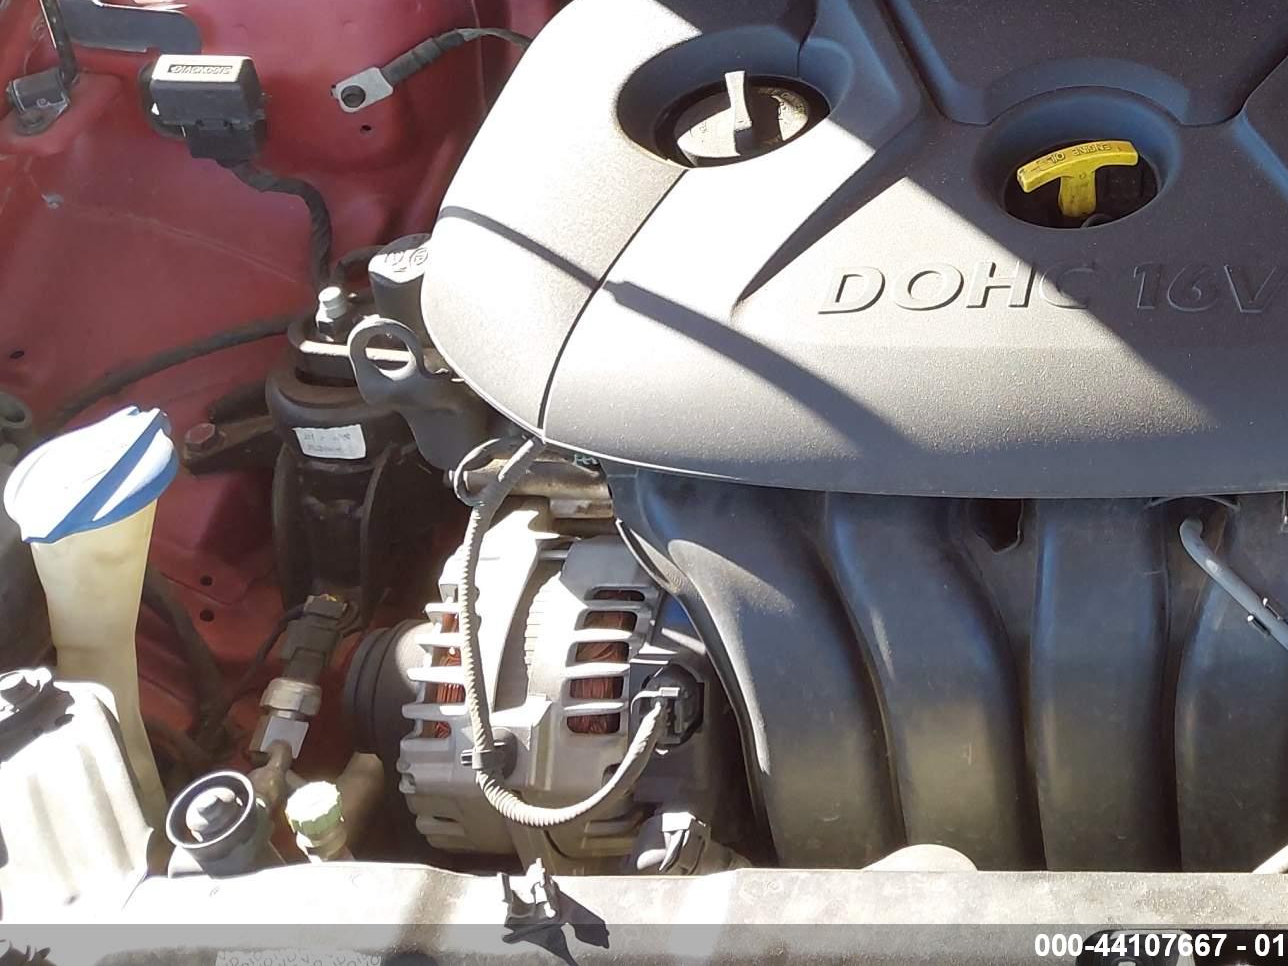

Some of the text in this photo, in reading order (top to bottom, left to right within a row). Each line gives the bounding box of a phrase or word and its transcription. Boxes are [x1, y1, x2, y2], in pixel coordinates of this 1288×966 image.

[1047, 143, 1111, 163] ENGINE OIL
[816, 261, 1283, 315] DOHC 16V
